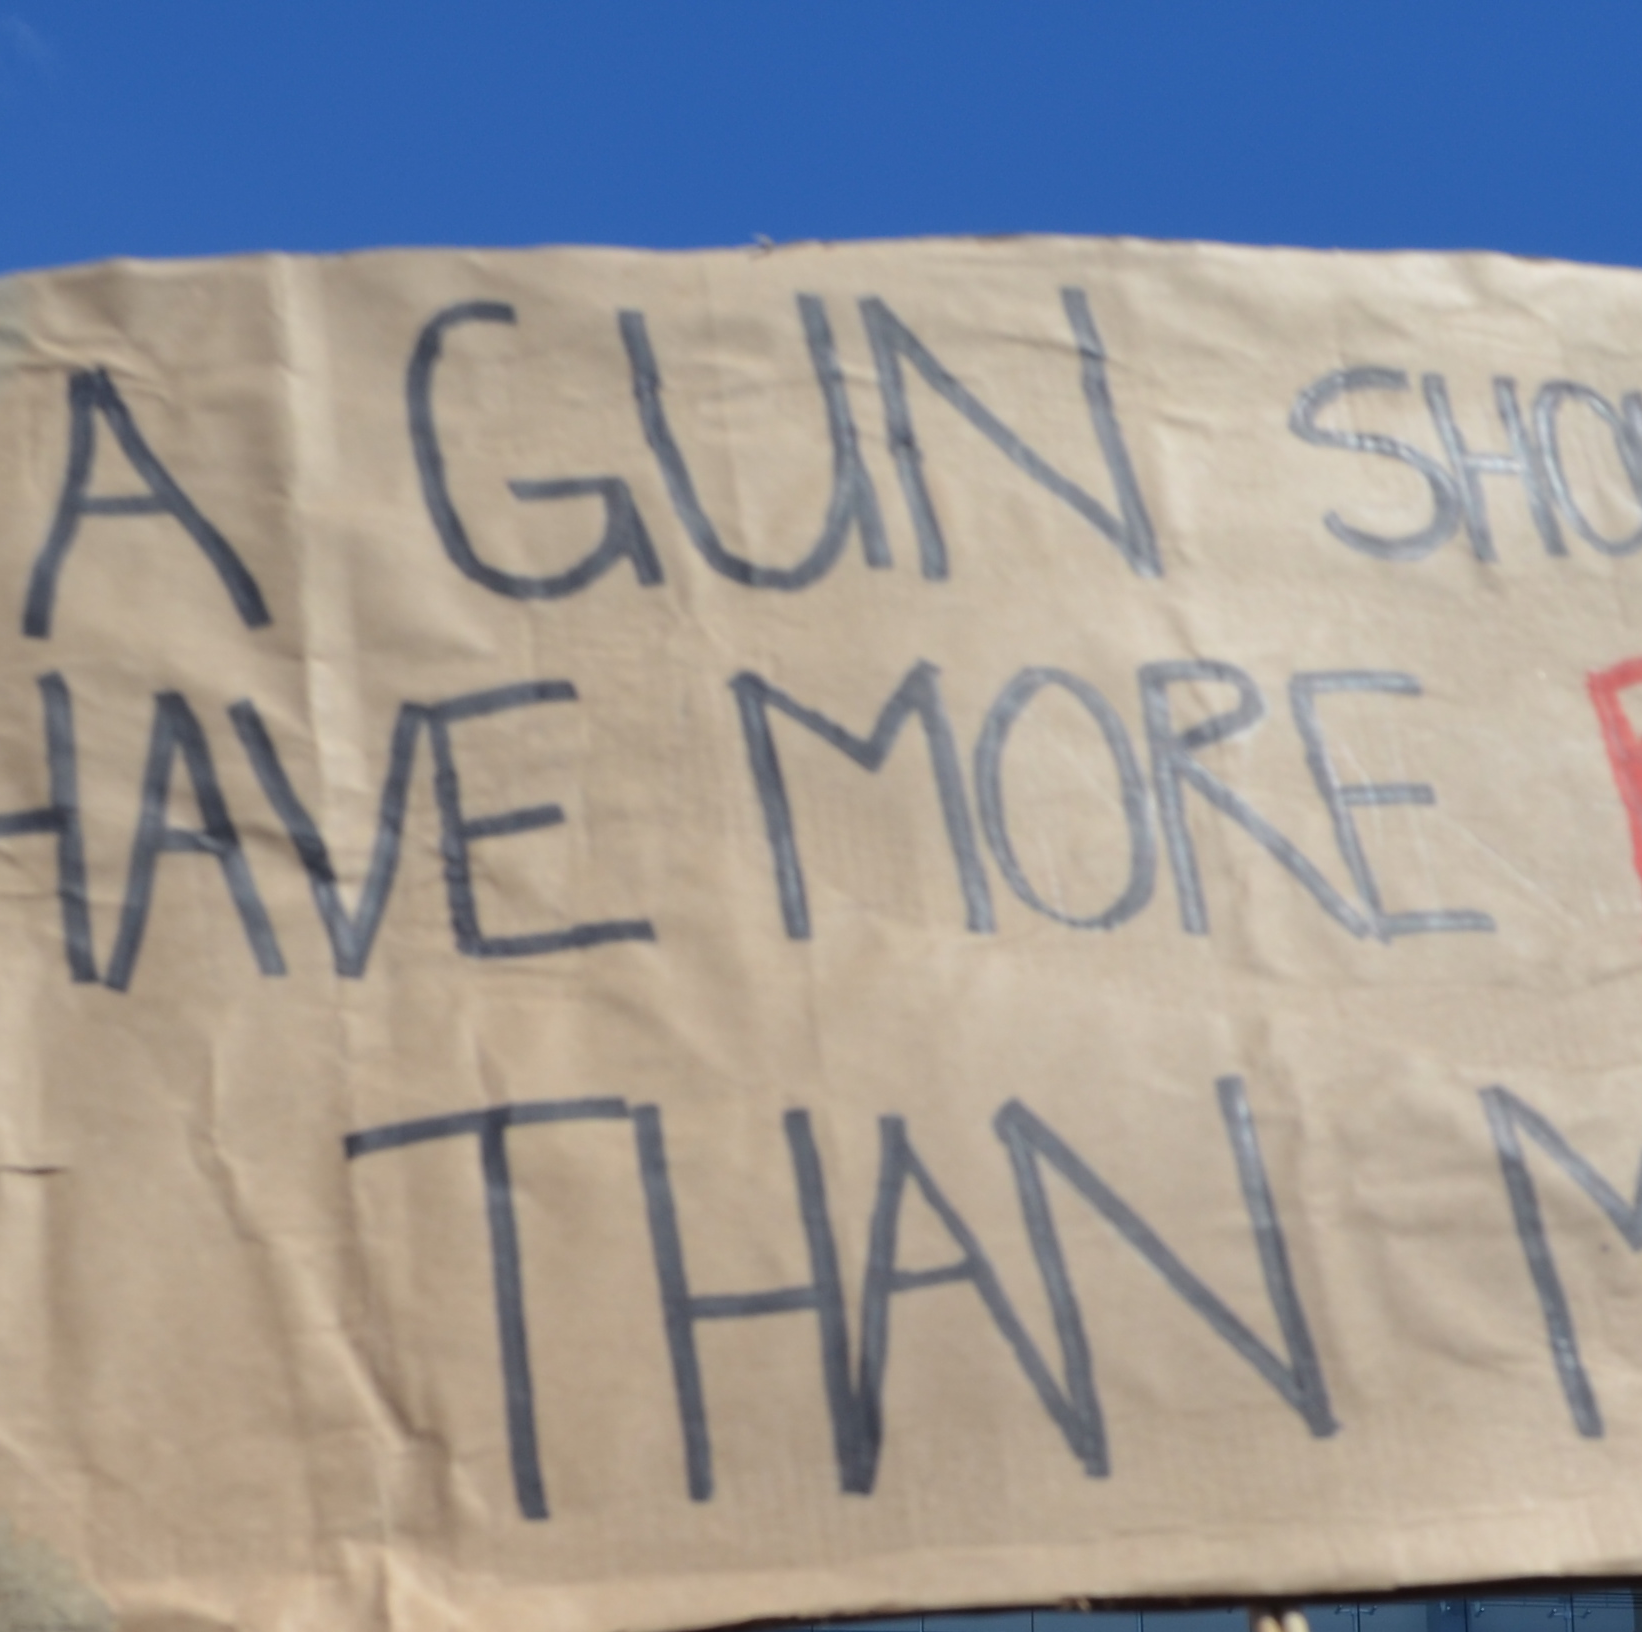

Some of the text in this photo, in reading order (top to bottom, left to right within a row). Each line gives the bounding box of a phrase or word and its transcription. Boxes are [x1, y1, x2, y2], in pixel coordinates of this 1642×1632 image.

[24, 367, 273, 639] A
[407, 286, 1164, 601] GUN
[730, 659, 1494, 945] MORE
[344, 1075, 1339, 1521] THAN
